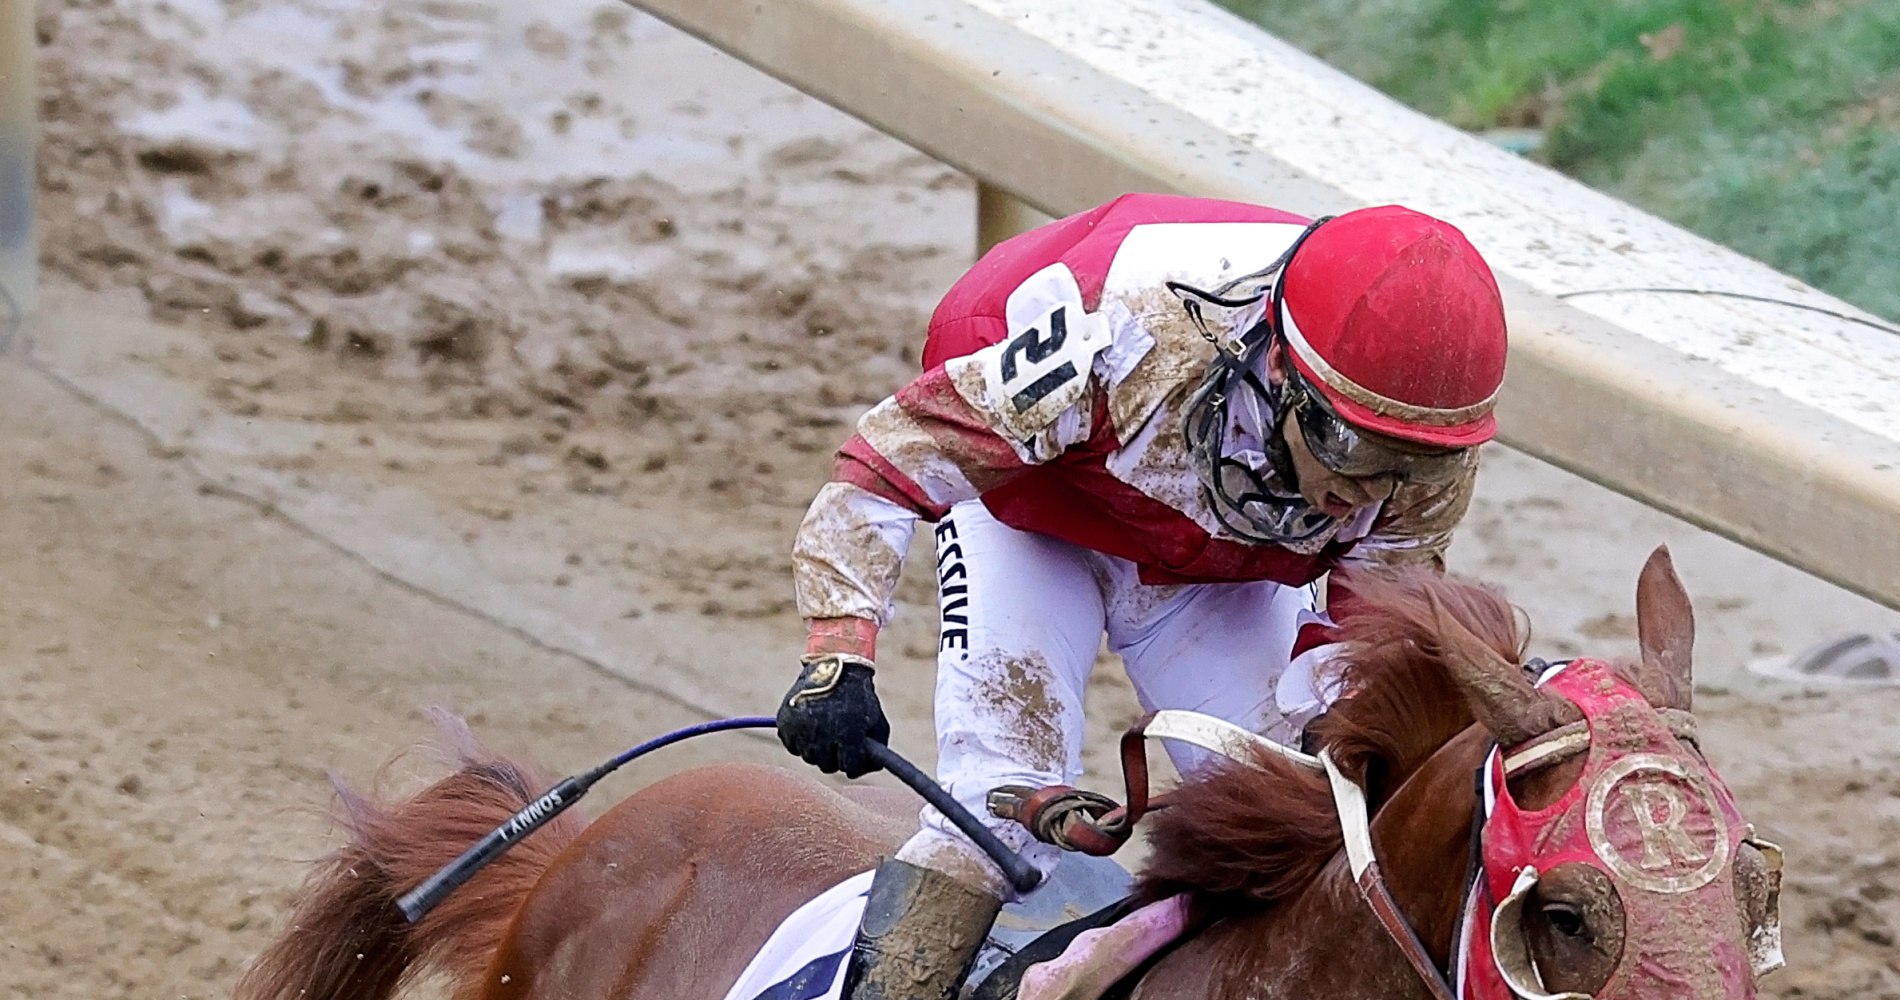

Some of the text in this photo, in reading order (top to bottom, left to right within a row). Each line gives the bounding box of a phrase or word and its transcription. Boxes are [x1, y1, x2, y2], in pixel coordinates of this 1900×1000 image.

[1001, 306, 1078, 415] 21
[510, 789, 564, 834] SONNY
[1618, 782, 1708, 869] R
